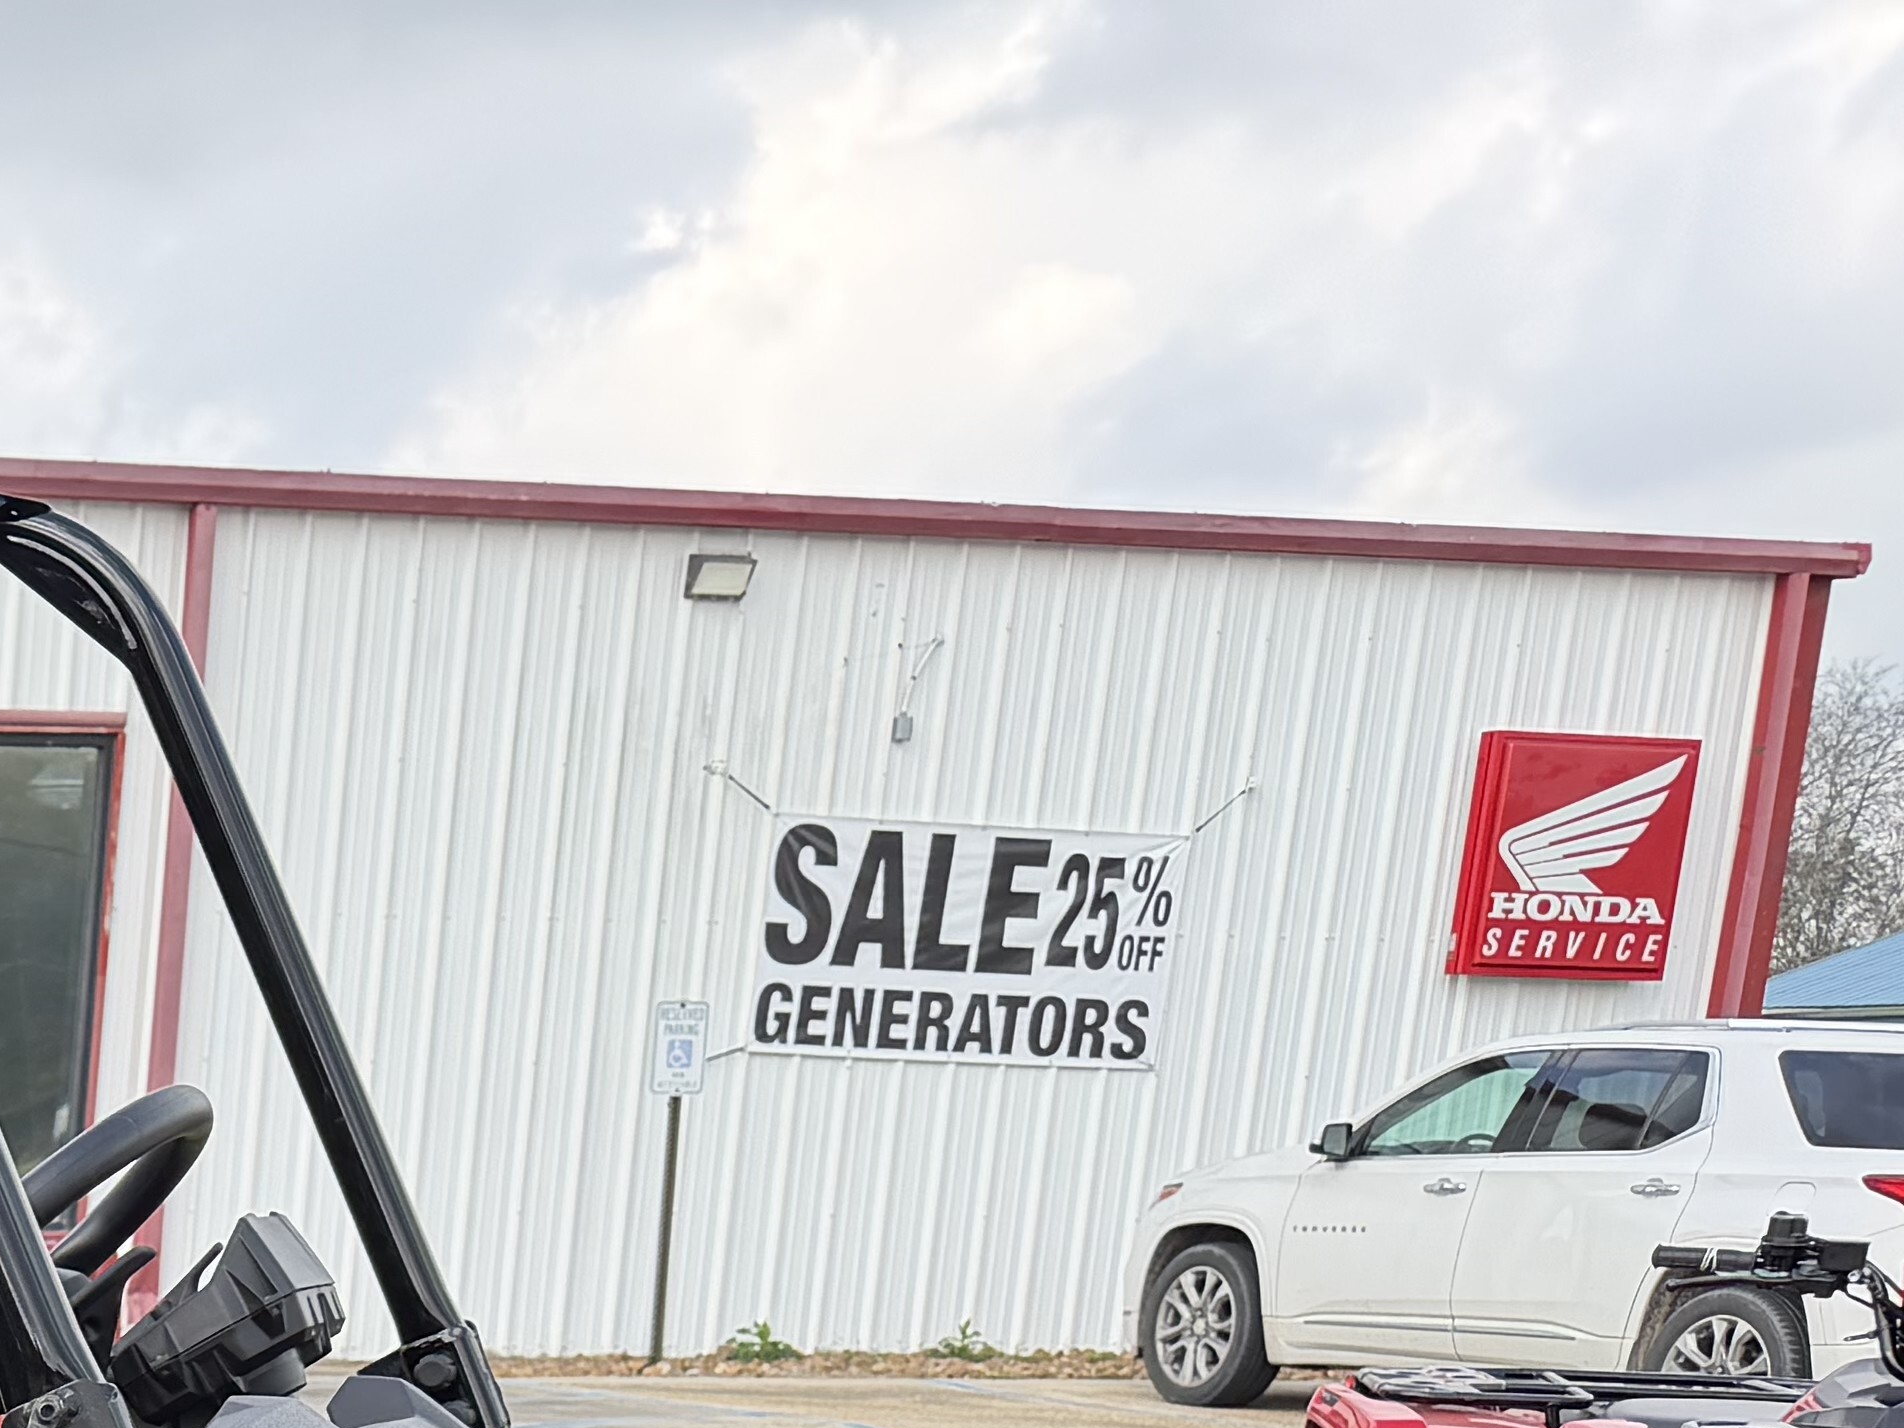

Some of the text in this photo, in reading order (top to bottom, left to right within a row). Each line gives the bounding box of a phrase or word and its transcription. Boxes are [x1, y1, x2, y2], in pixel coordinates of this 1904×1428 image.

[765, 824, 1172, 975] SALE 25% OFF
[1487, 892, 1665, 924] HONDA
[1482, 928, 1663, 961] SERVICE
[754, 981, 1150, 1060] GENERATORS
